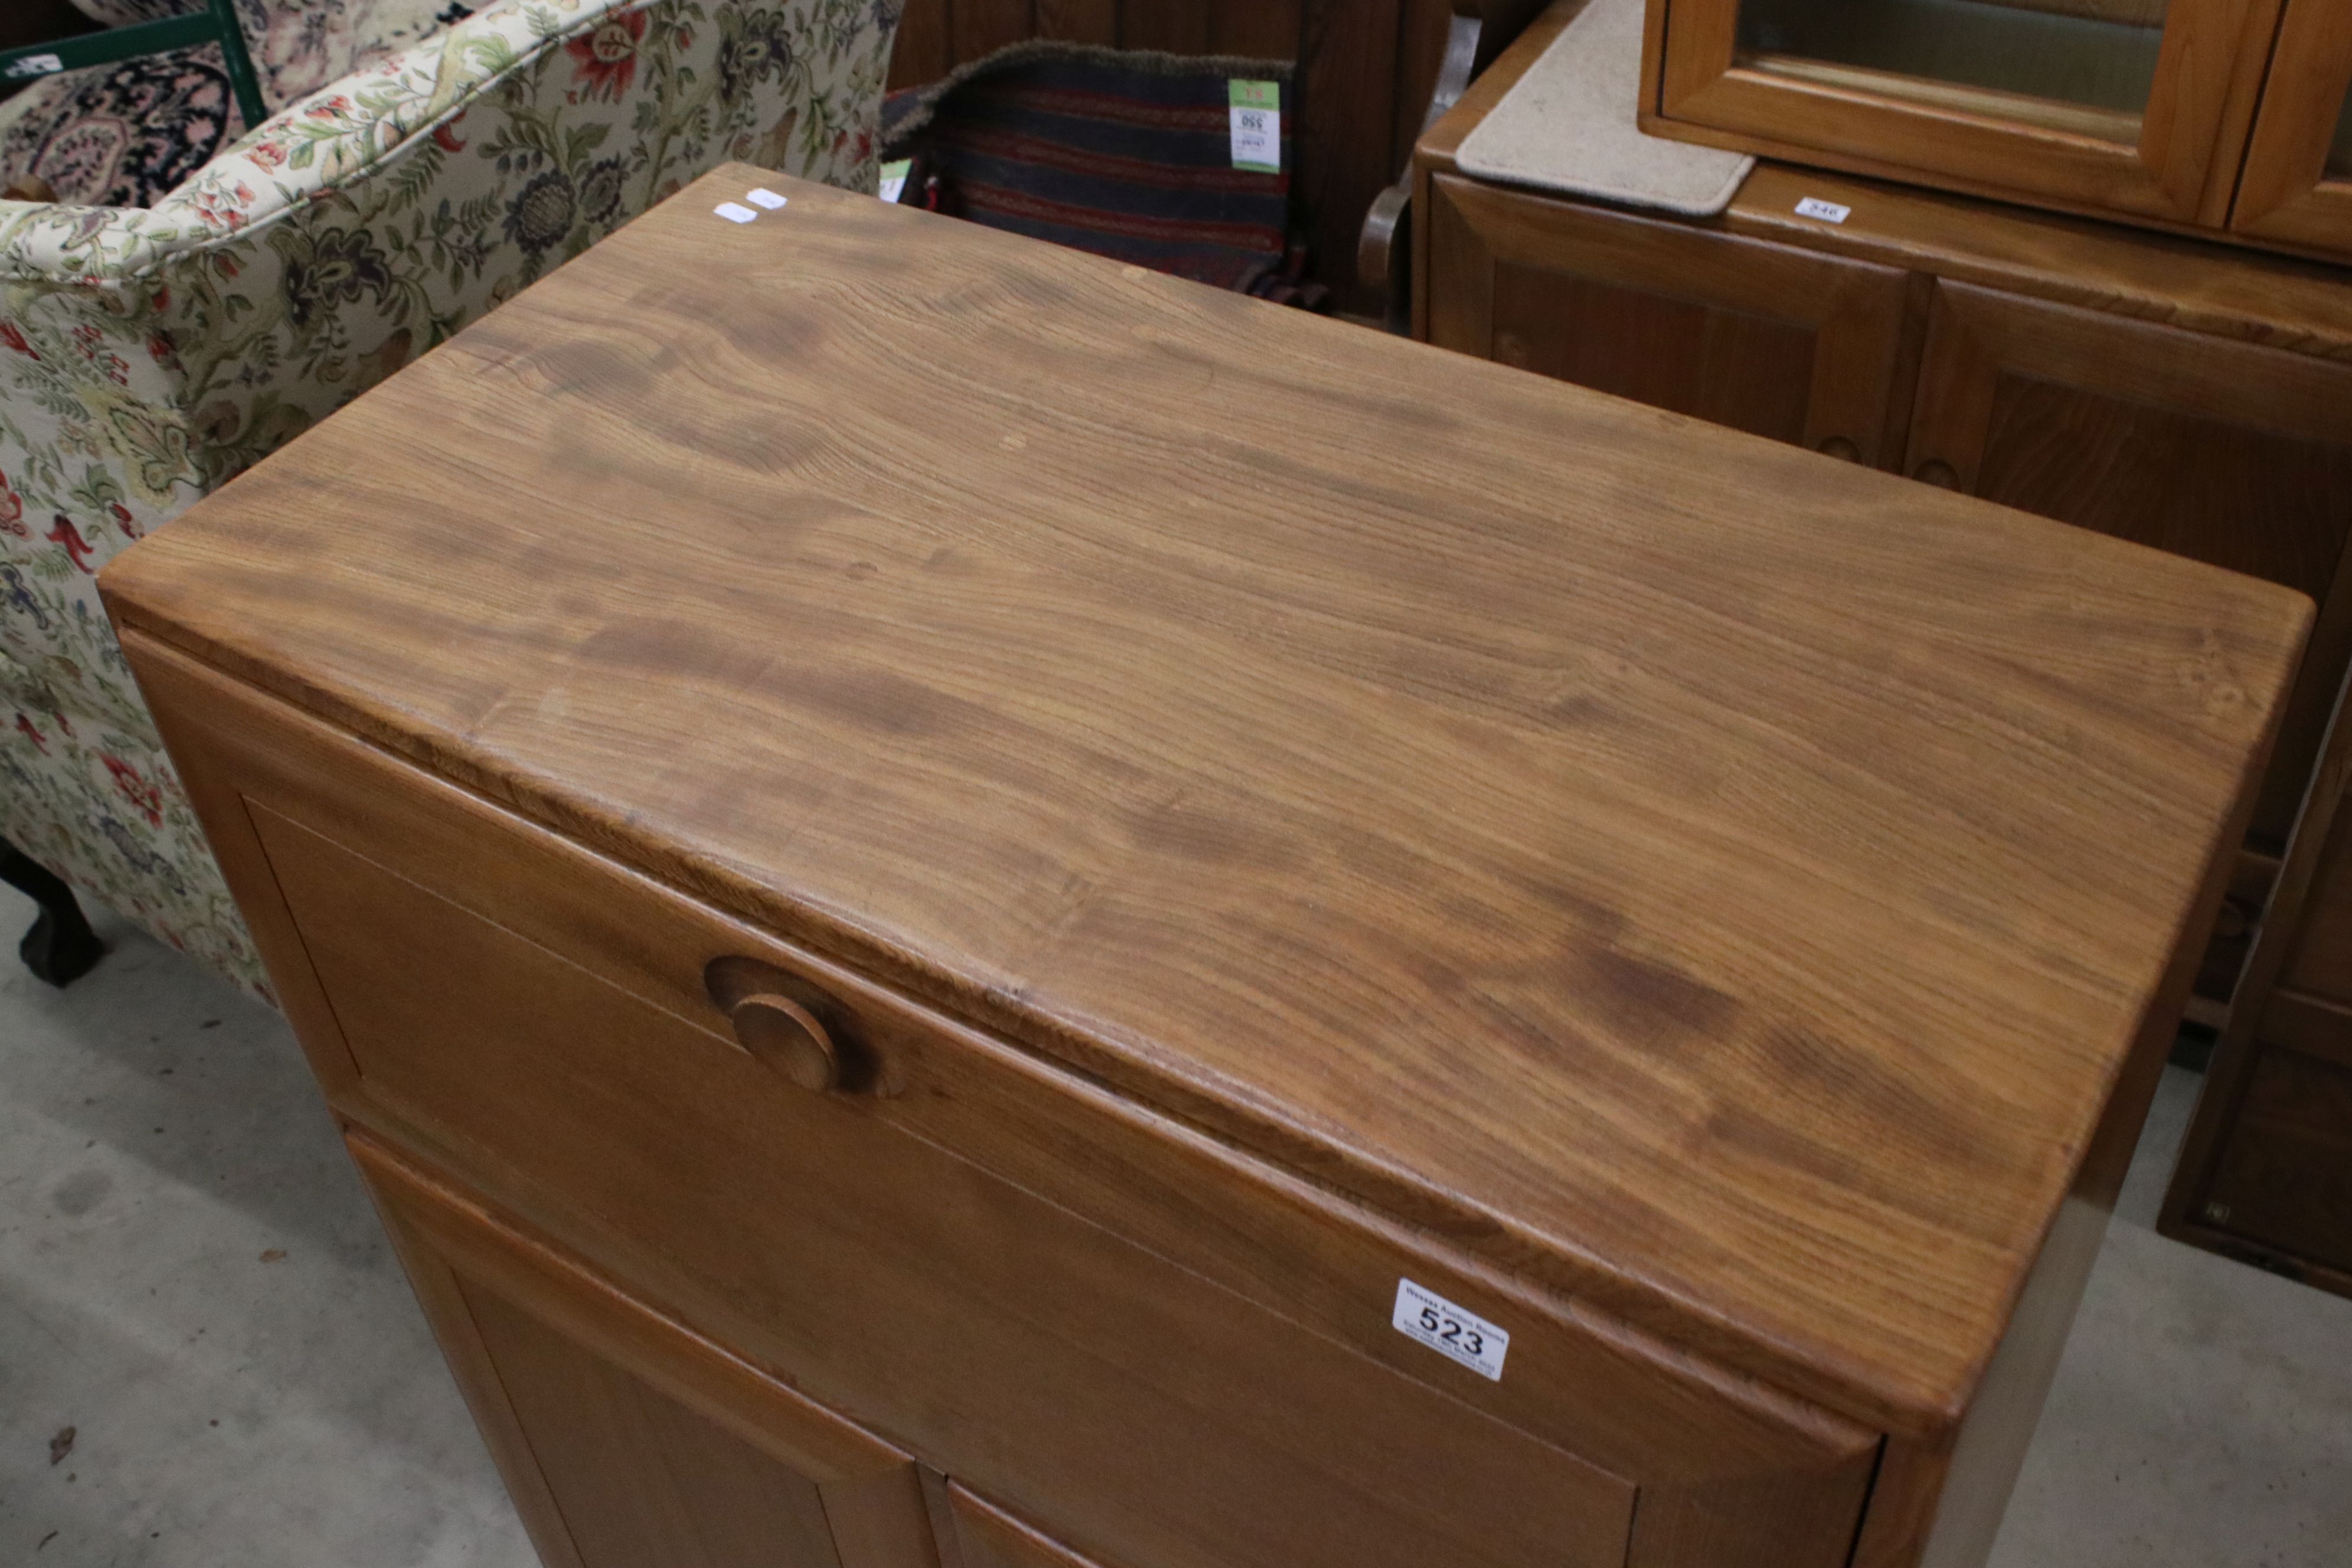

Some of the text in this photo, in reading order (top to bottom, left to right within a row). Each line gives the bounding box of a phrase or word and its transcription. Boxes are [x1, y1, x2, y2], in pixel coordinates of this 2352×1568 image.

[1406, 1286, 1505, 1344] Wessex Auction Rooms
[1419, 1306, 1483, 1355] 523
